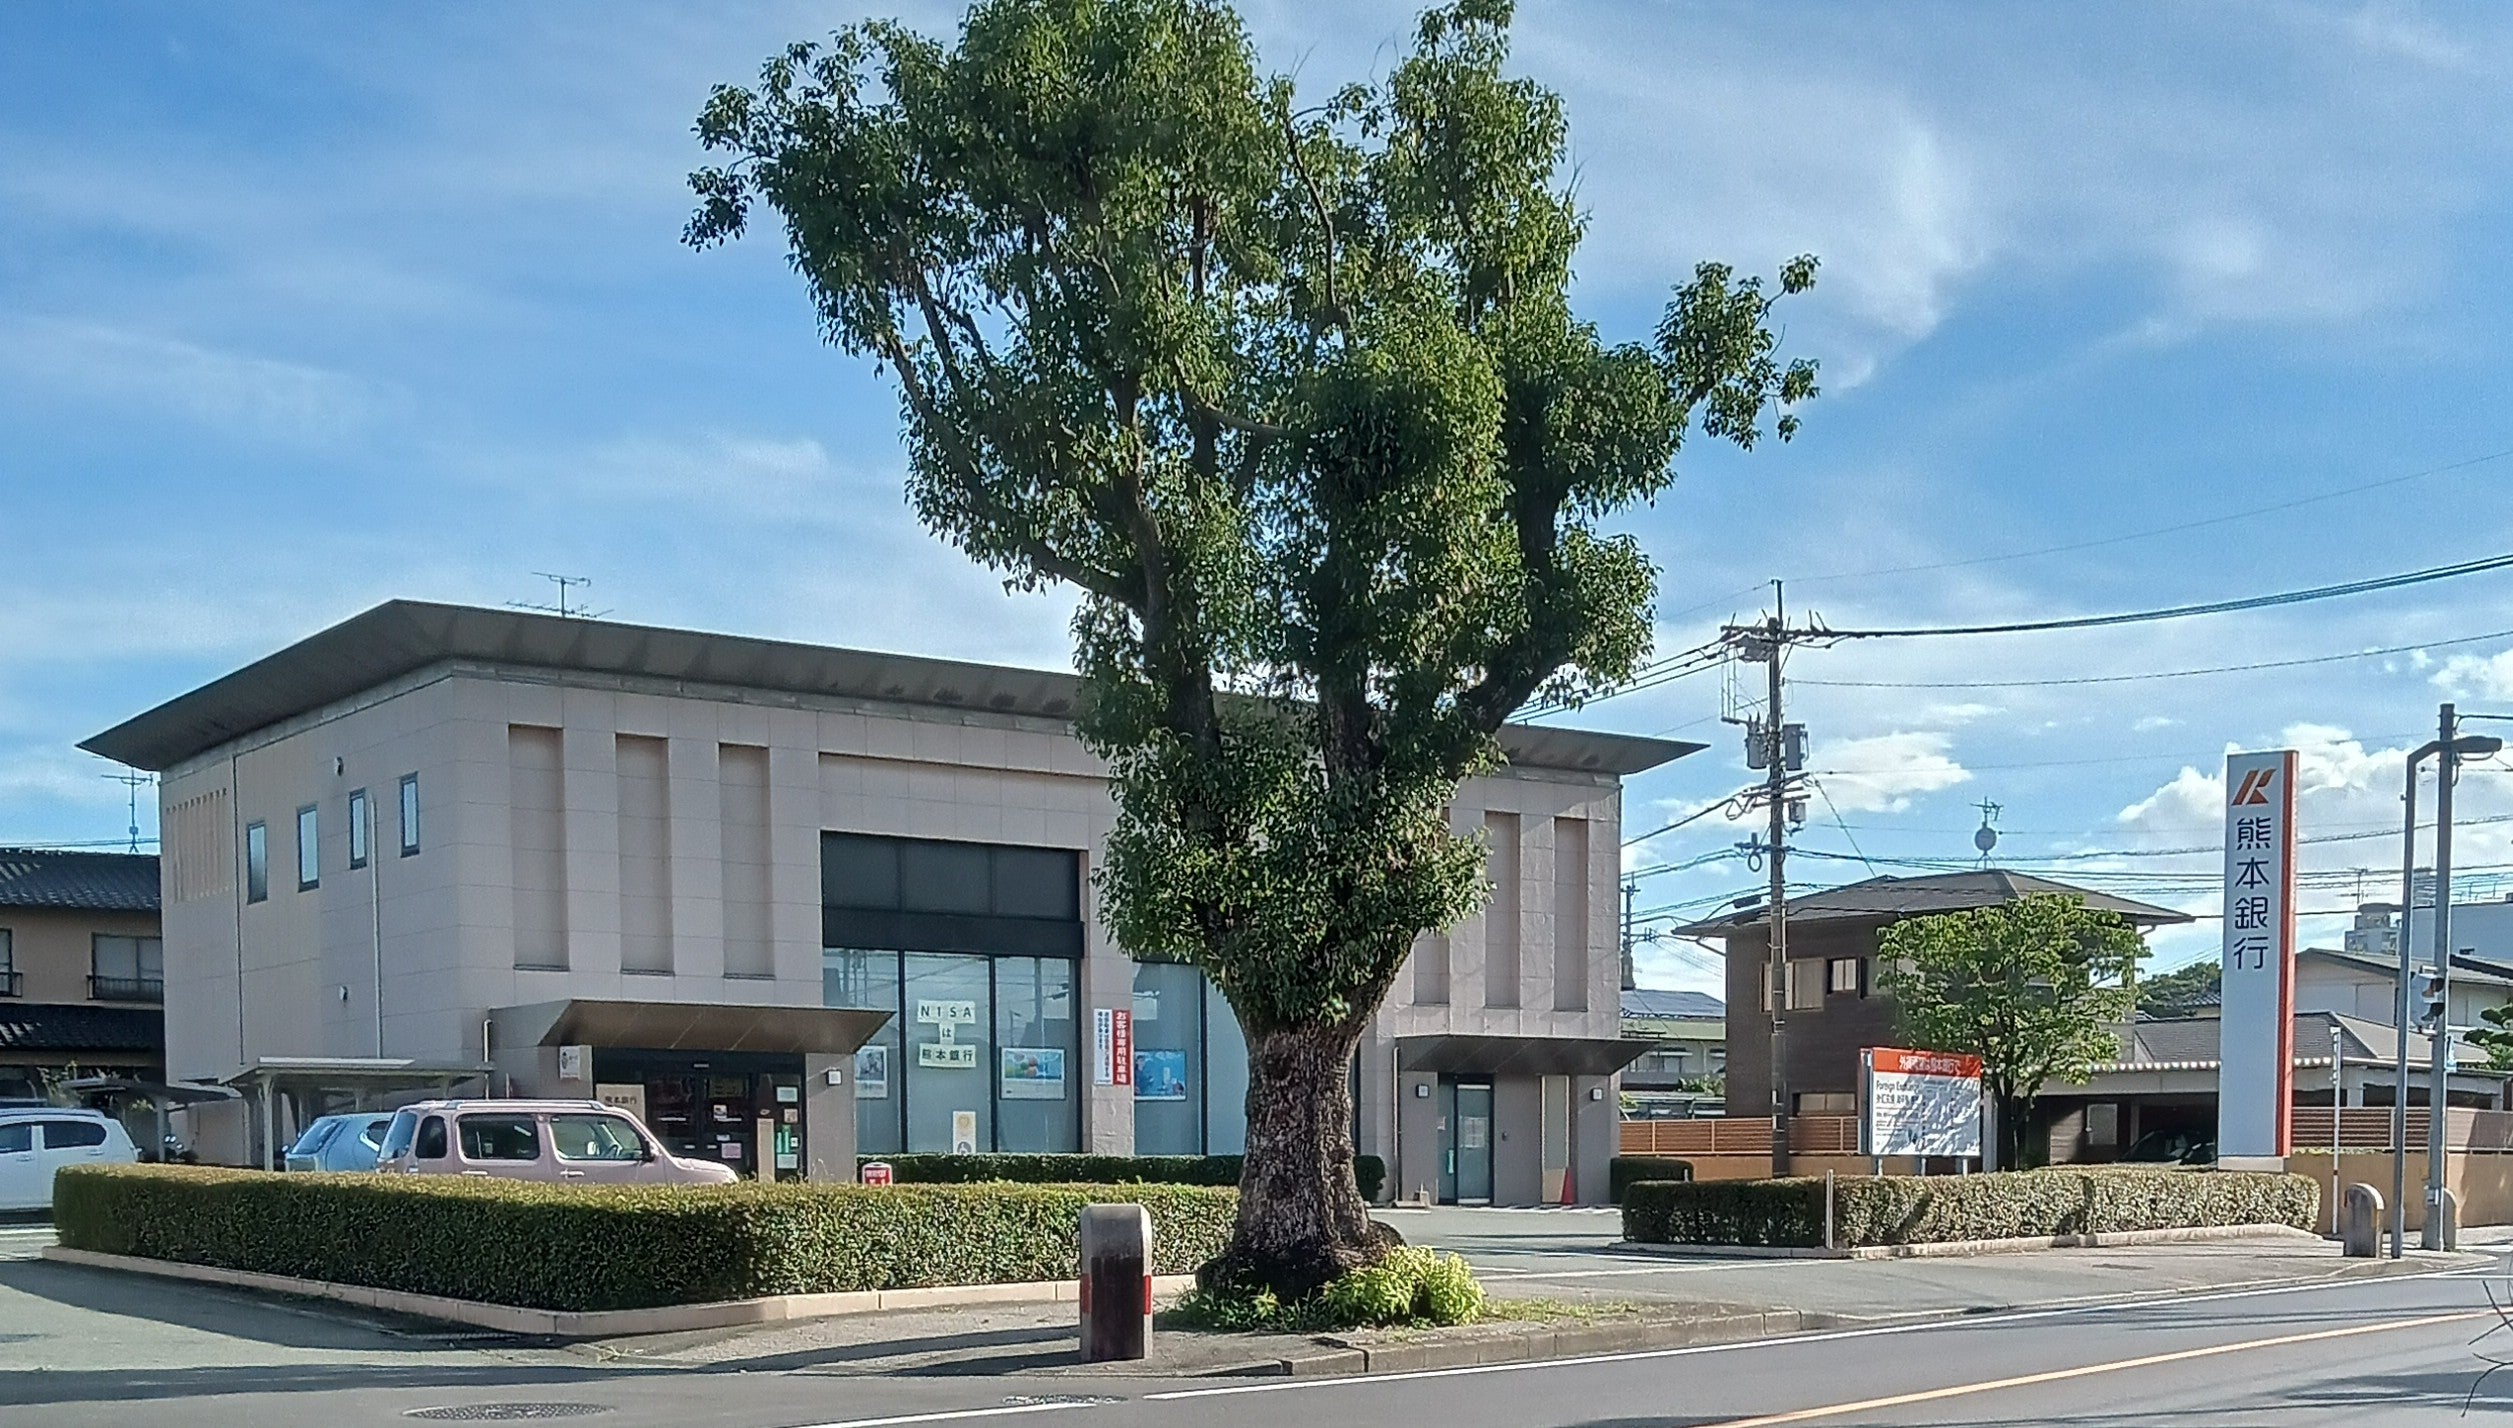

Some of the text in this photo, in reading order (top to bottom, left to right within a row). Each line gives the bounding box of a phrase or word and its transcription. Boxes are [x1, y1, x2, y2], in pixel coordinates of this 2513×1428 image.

[2234, 817, 2271, 970] 熊本銀行
[920, 1006, 972, 1018] NISA
[942, 1028, 951, 1038] は
